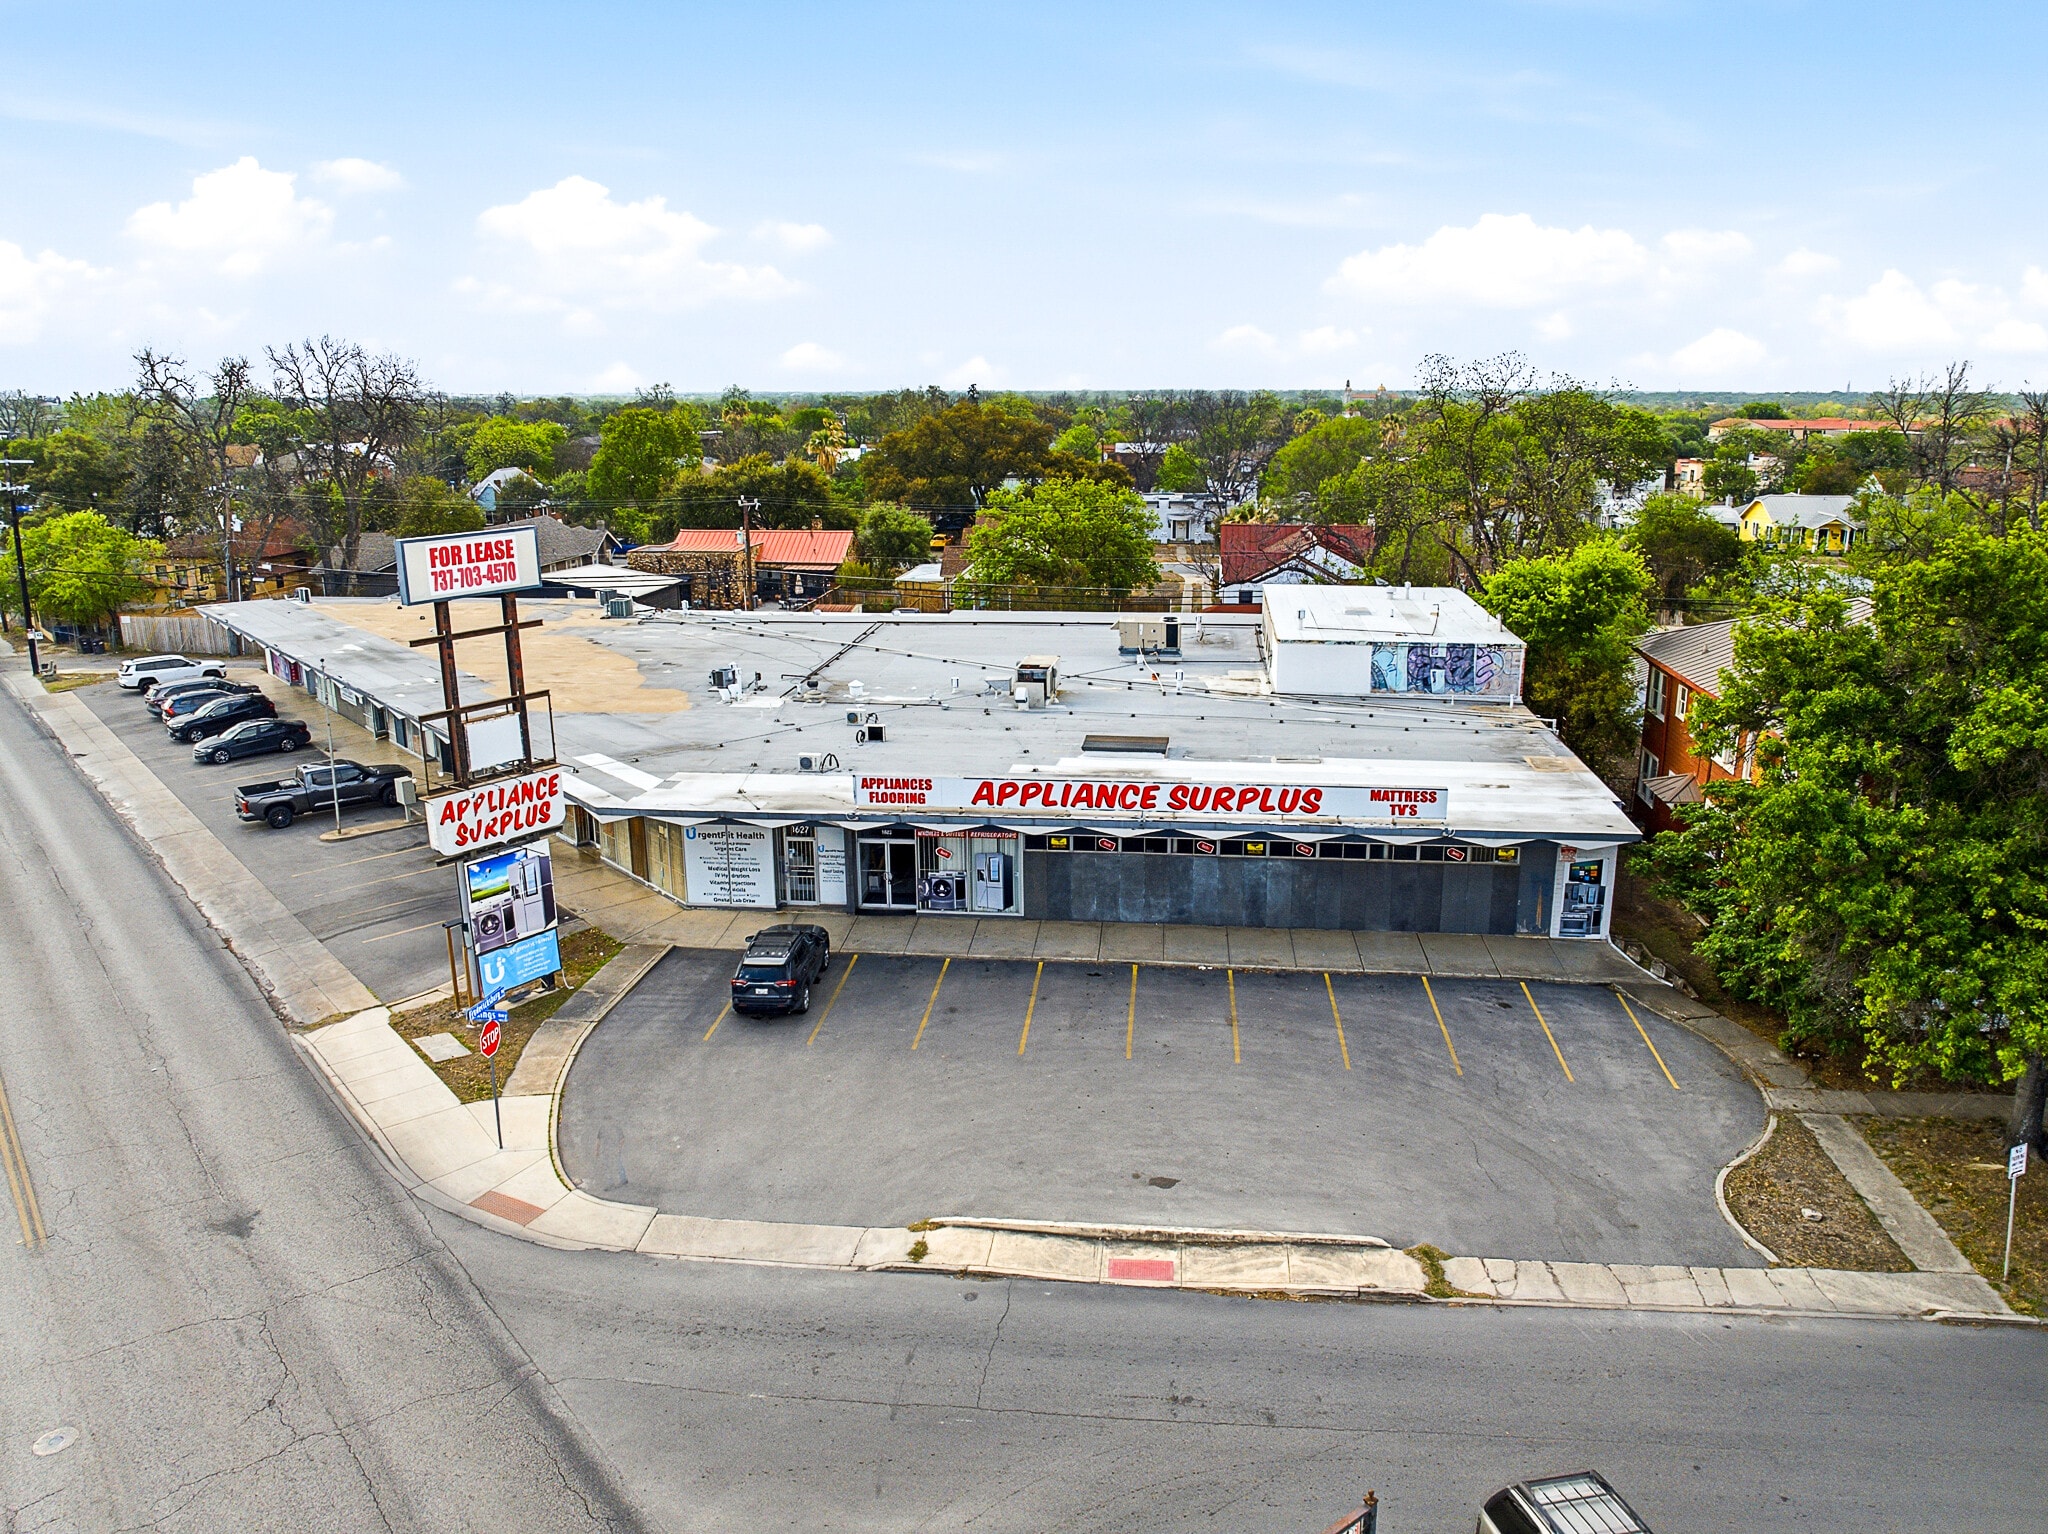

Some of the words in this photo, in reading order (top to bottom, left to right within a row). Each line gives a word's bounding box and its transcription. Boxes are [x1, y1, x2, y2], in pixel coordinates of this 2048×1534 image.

[429, 545, 462, 568] FOR
[466, 539, 515, 564] LEASE
[431, 561, 517, 592] 737-703-4570
[861, 777, 933, 791] APPLIANCES
[440, 773, 560, 826] APPLIANCE
[869, 791, 926, 804] FLOORING
[971, 780, 1158, 810] APPLIANCE
[1167, 784, 1324, 814] SURPLUS
[1370, 789, 1438, 803] MATTRESS
[1389, 804, 1418, 816] TV'S
[455, 801, 551, 846] SURPLUS
[791, 825, 809, 834] 1627
[736, 831, 766, 840] Health
[970, 831, 1018, 839] REFRIGERATORS
[482, 1027, 499, 1050] STOP
